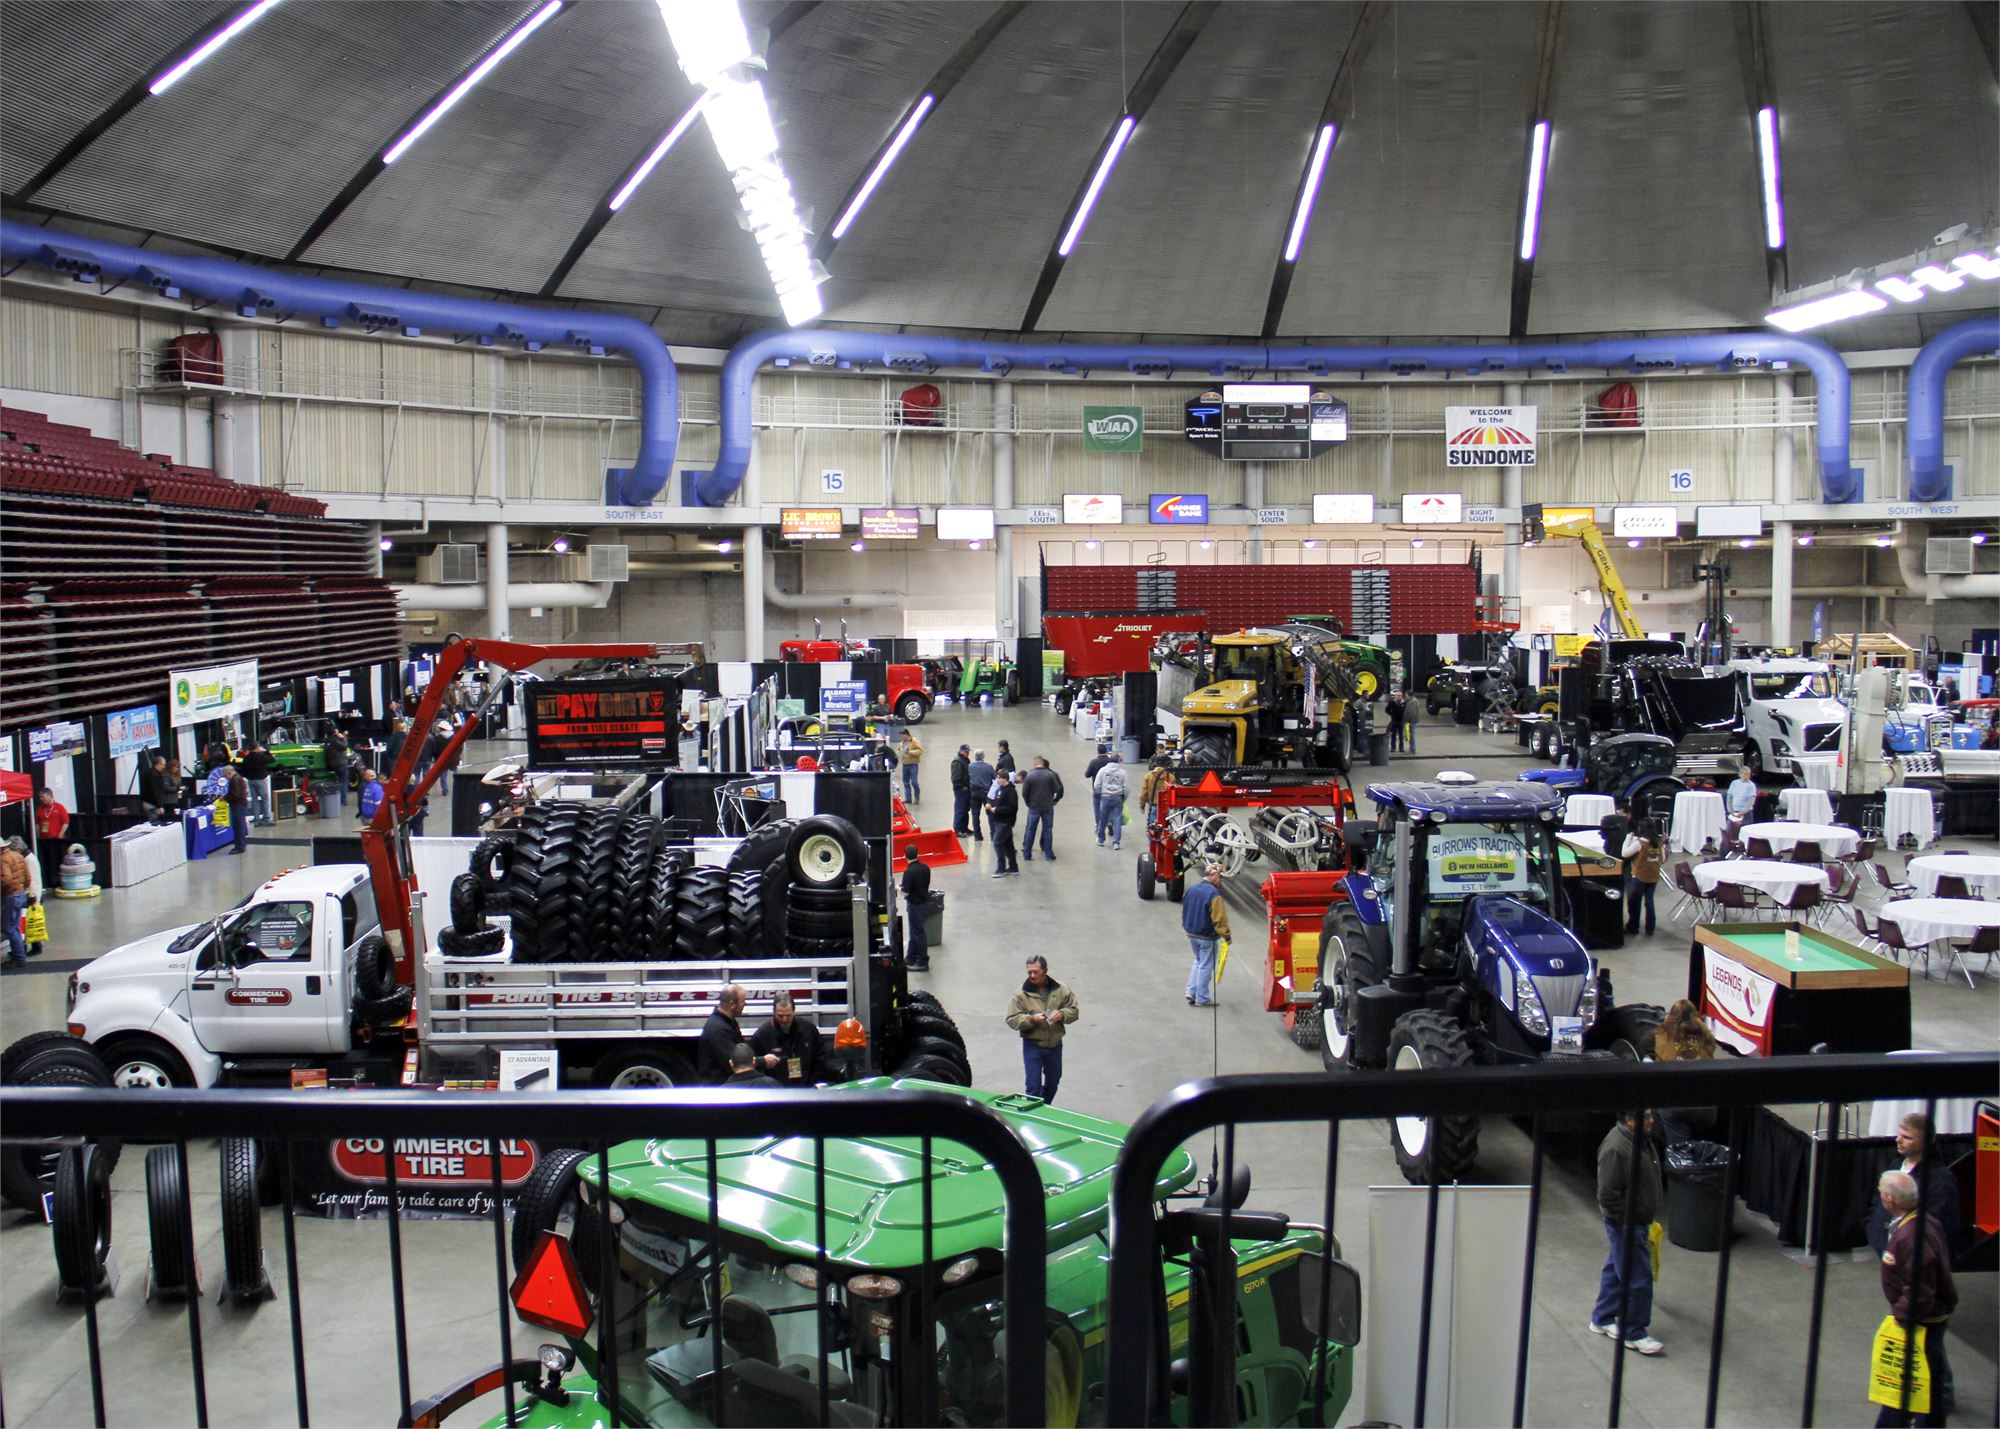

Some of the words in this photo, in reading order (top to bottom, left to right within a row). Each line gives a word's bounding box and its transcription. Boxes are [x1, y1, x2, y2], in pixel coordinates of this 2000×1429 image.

[1095, 421, 1130, 433] WIAA
[1449, 449, 1535, 465] SUNDOME
[823, 473, 843, 489] 15
[1671, 472, 1692, 488] 16
[605, 510, 636, 519] SOUTH
[641, 511, 664, 519] EAST
[1887, 506, 1922, 515] SOUTH
[1929, 505, 1960, 514] WEST
[1596, 549, 1611, 574] GEHL
[1121, 624, 1152, 632] TRIOLIET
[556, 693, 598, 719] PAY
[567, 724, 589, 733] FARM
[609, 723, 639, 732] DEBATE
[1432, 837, 1478, 856] BURROWS
[1480, 837, 1522, 857] TRACTOR
[1476, 862, 1509, 870] HOLLAND
[1712, 964, 1743, 992] LEGENDS
[611, 991, 671, 1001] Saes
[679, 991, 695, 1000] &
[1711, 979, 1743, 1002] CASINO
[406, 1156, 465, 1176] TIRE
[340, 1194, 362, 1204] our
[360, 1189, 406, 1212] famy
[409, 1191, 435, 1207] take
[438, 1195, 464, 1208] care
[467, 1191, 484, 1213] of
